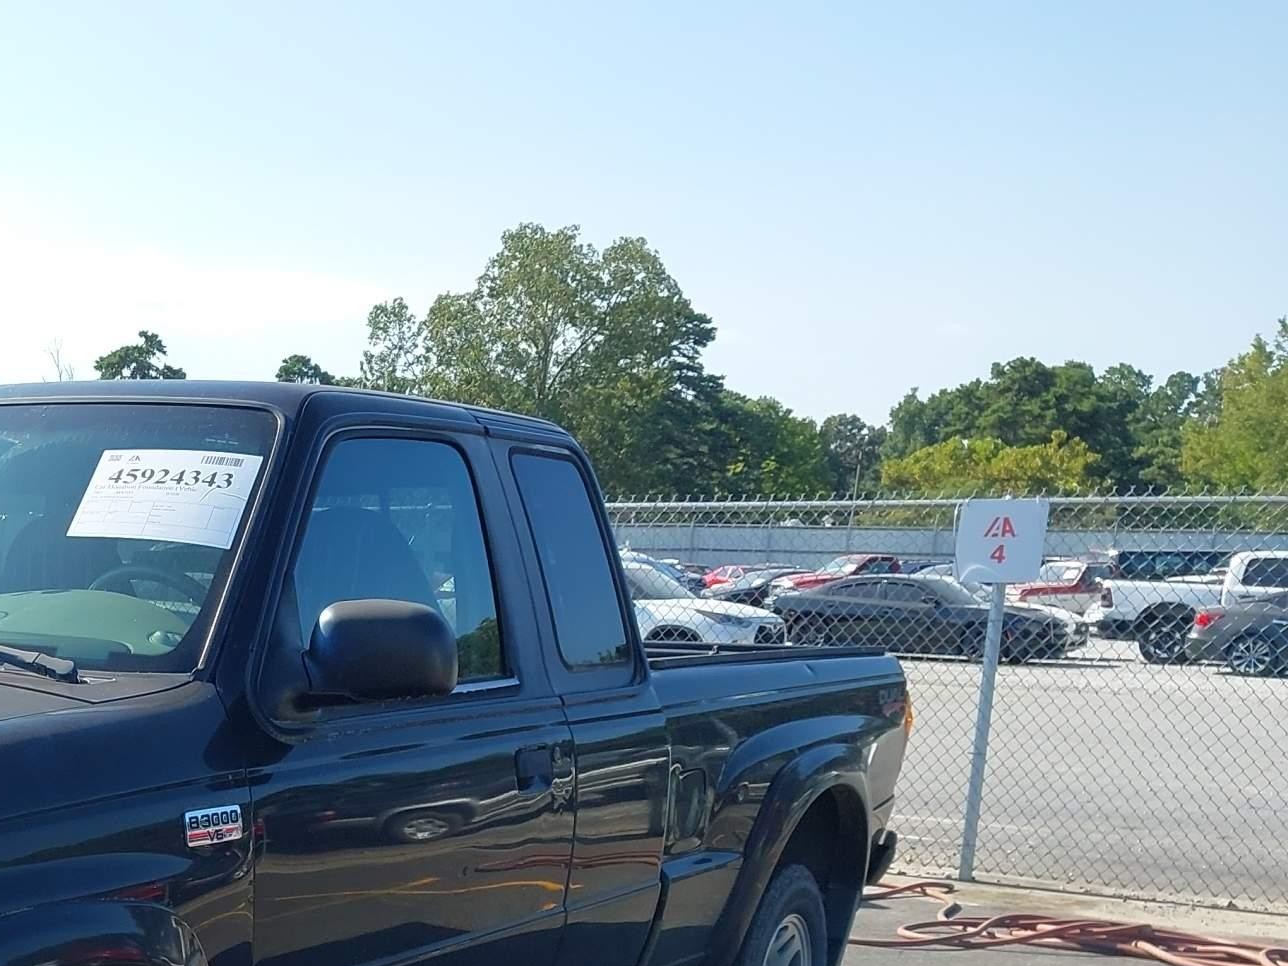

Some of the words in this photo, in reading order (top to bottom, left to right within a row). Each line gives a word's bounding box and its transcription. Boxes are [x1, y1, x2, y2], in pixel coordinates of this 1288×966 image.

[107, 468, 234, 489] 45924343
[990, 544, 1006, 564] 4
[188, 809, 239, 830] B3000
[207, 828, 224, 842] V6
